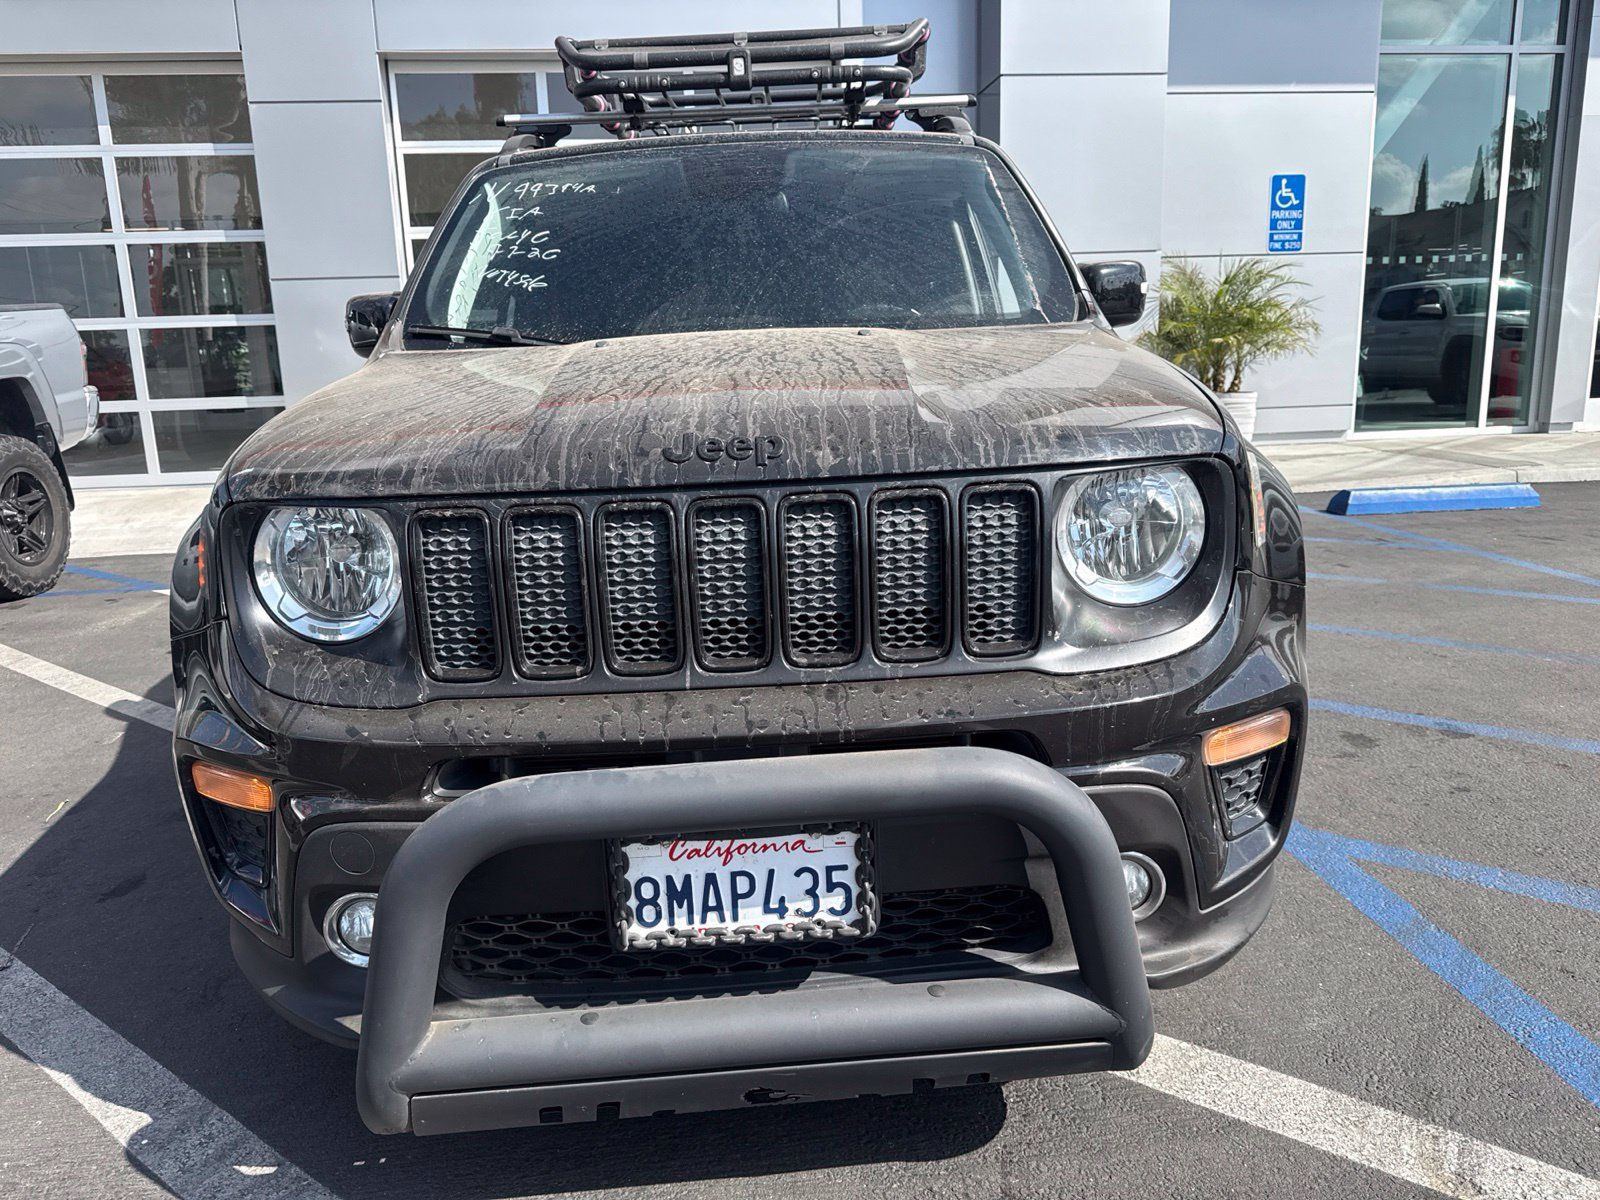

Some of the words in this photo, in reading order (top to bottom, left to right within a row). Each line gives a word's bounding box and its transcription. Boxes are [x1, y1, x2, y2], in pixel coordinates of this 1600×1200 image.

[1271, 209, 1303, 220] PARKING
[1277, 220, 1296, 230] ONLY
[1270, 241, 1282, 250] FINE
[661, 432, 785, 468] Jeep
[668, 838, 823, 867] California
[634, 863, 853, 929] 8MAP435
